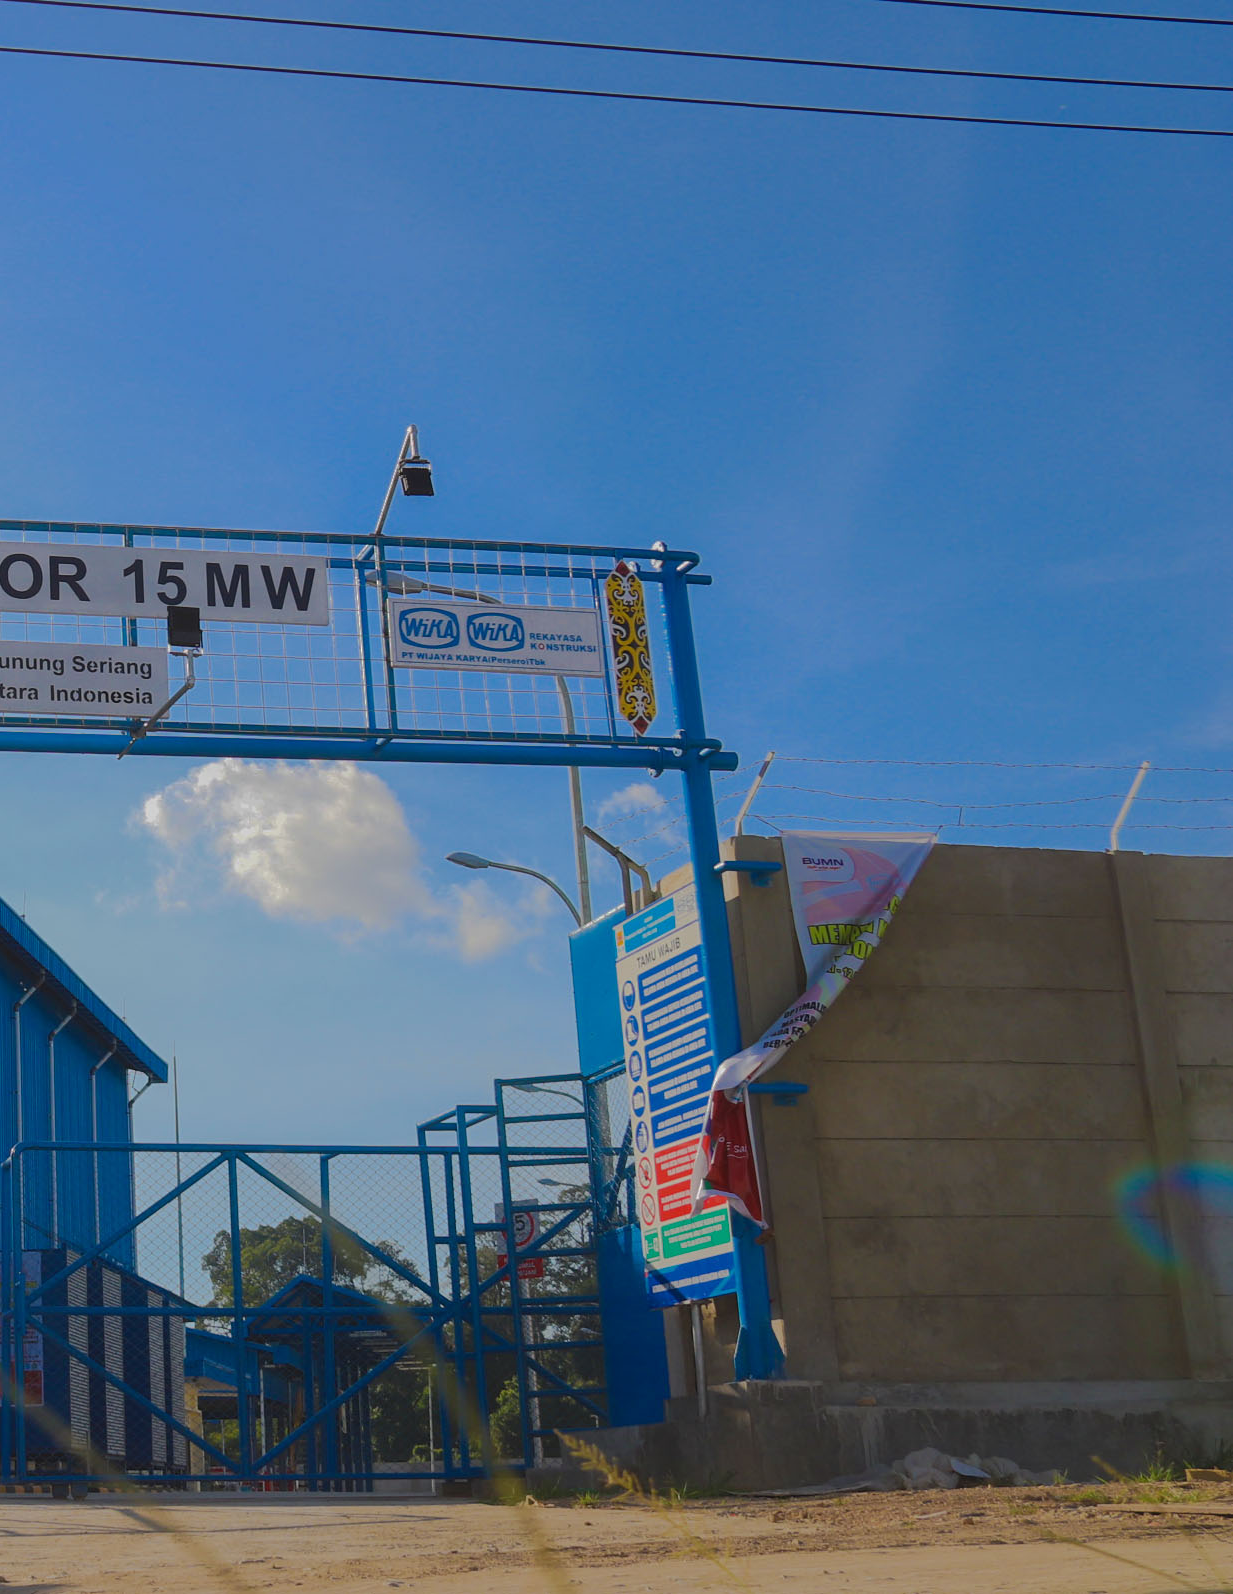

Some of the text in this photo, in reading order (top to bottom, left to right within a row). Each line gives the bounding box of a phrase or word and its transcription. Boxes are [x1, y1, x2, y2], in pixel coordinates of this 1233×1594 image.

[122, 558, 188, 606] 15
[206, 562, 316, 612] MW
[529, 632, 583, 643] REKAYASA
[530, 643, 597, 653] KONSTRUKSI
[416, 652, 453, 661] WIJAYA
[72, 655, 153, 680] Seriang
[50, 685, 154, 705] Indonesia
[801, 857, 844, 866] BUMN
[637, 937, 681, 968] TAMU WAJIB
